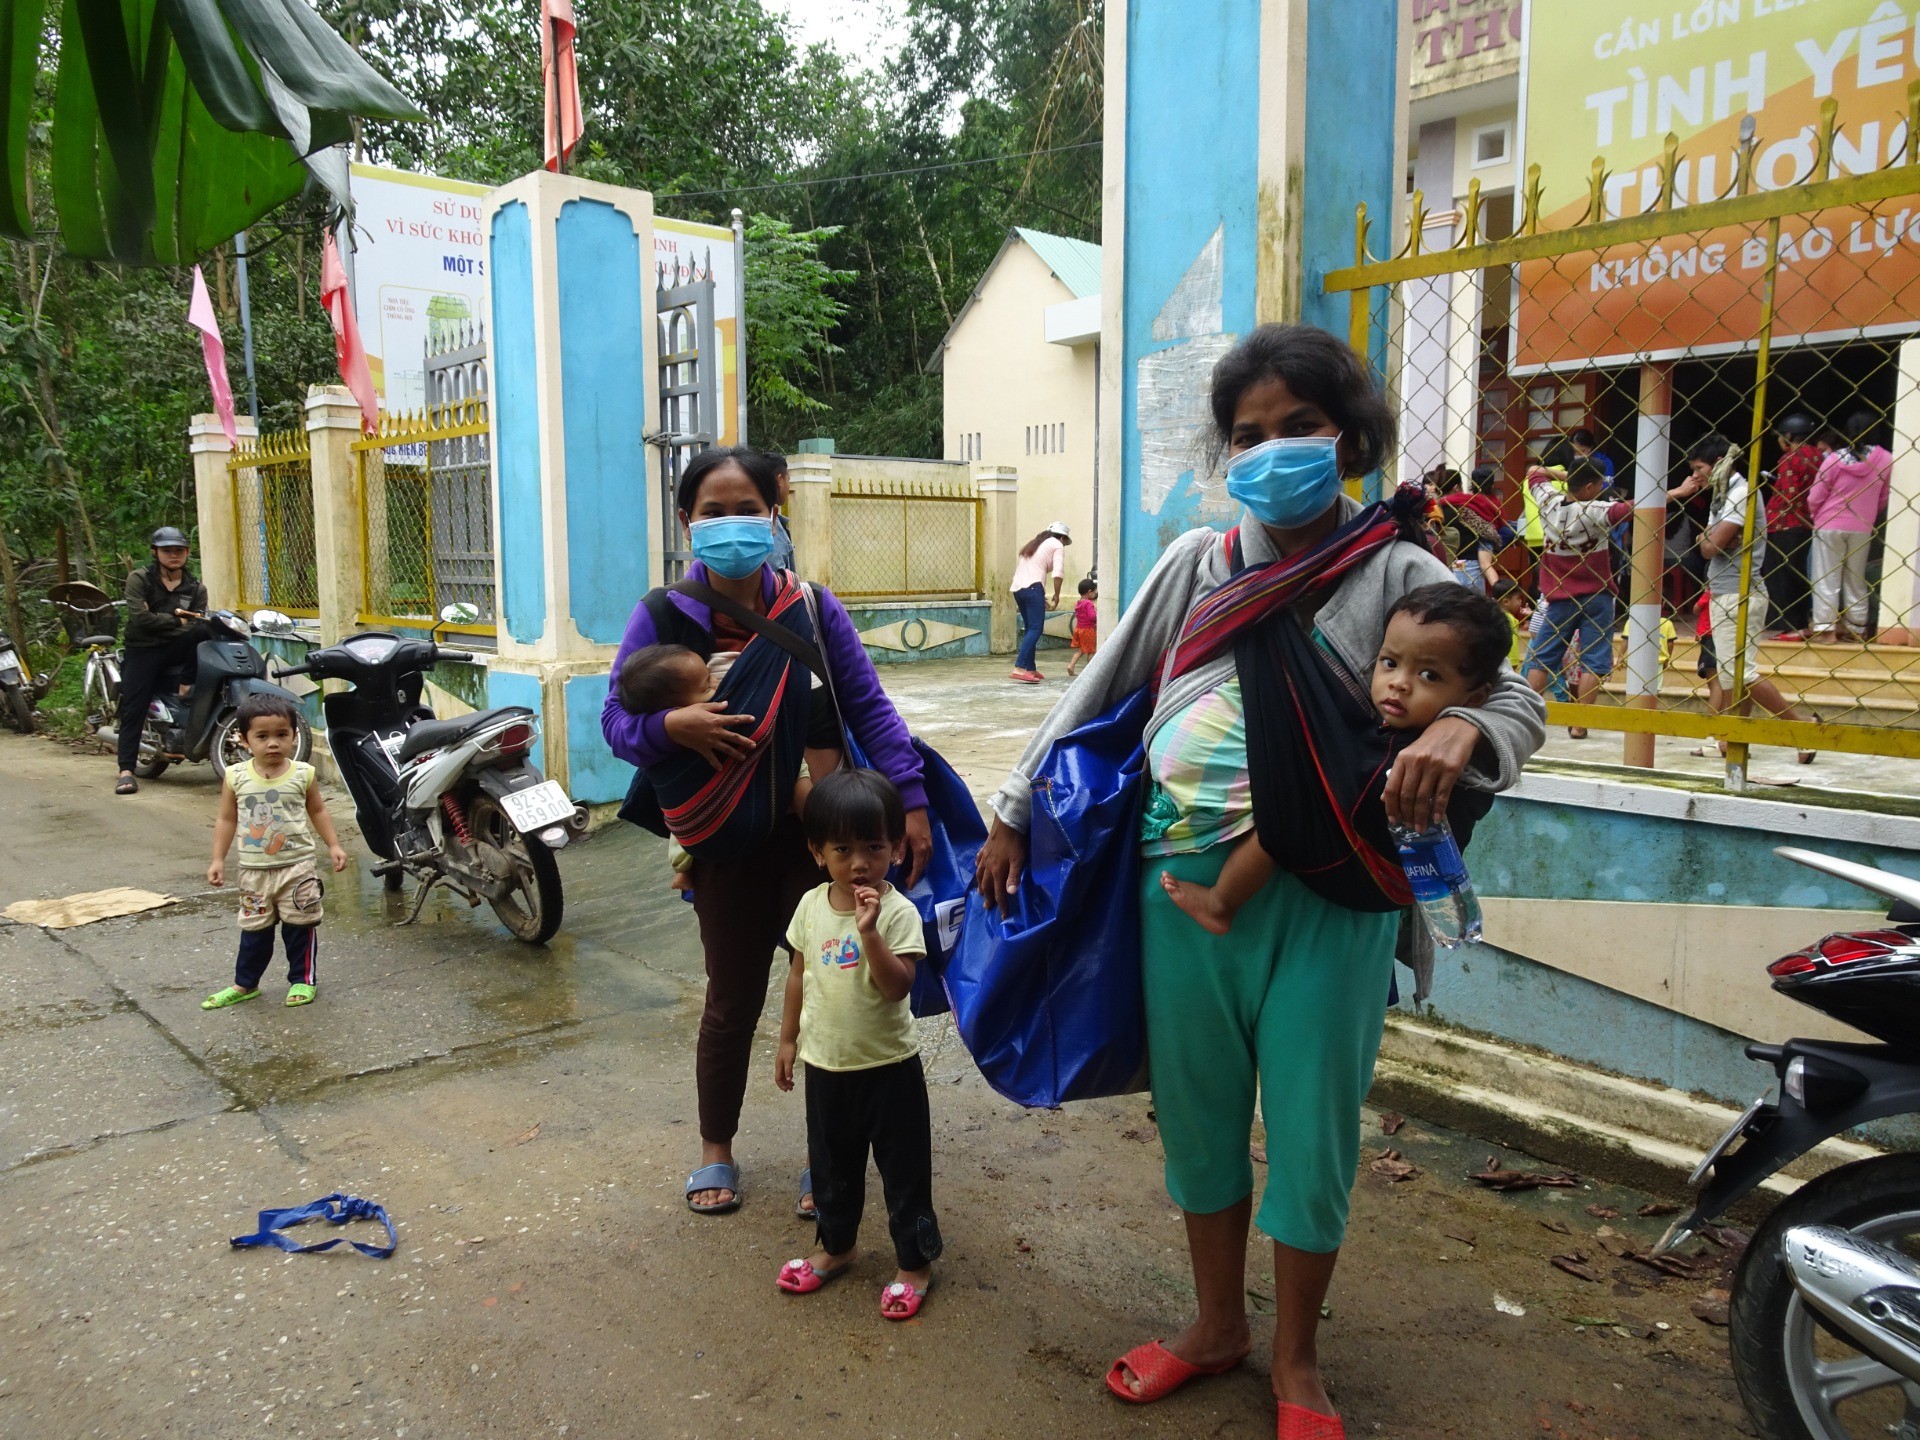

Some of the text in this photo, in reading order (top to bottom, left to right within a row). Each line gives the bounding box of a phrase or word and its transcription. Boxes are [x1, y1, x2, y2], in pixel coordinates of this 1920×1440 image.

[1585, 0, 1920, 147] TÌNH YÊ
[386, 216, 405, 235] VÌ
[409, 220, 443, 240] SỨC
[443, 254, 474, 276] MỘT
[1590, 243, 1727, 291] KHÔNG
[1741, 226, 1833, 272] BẠO
[1403, 863, 1439, 879] UAFINA
